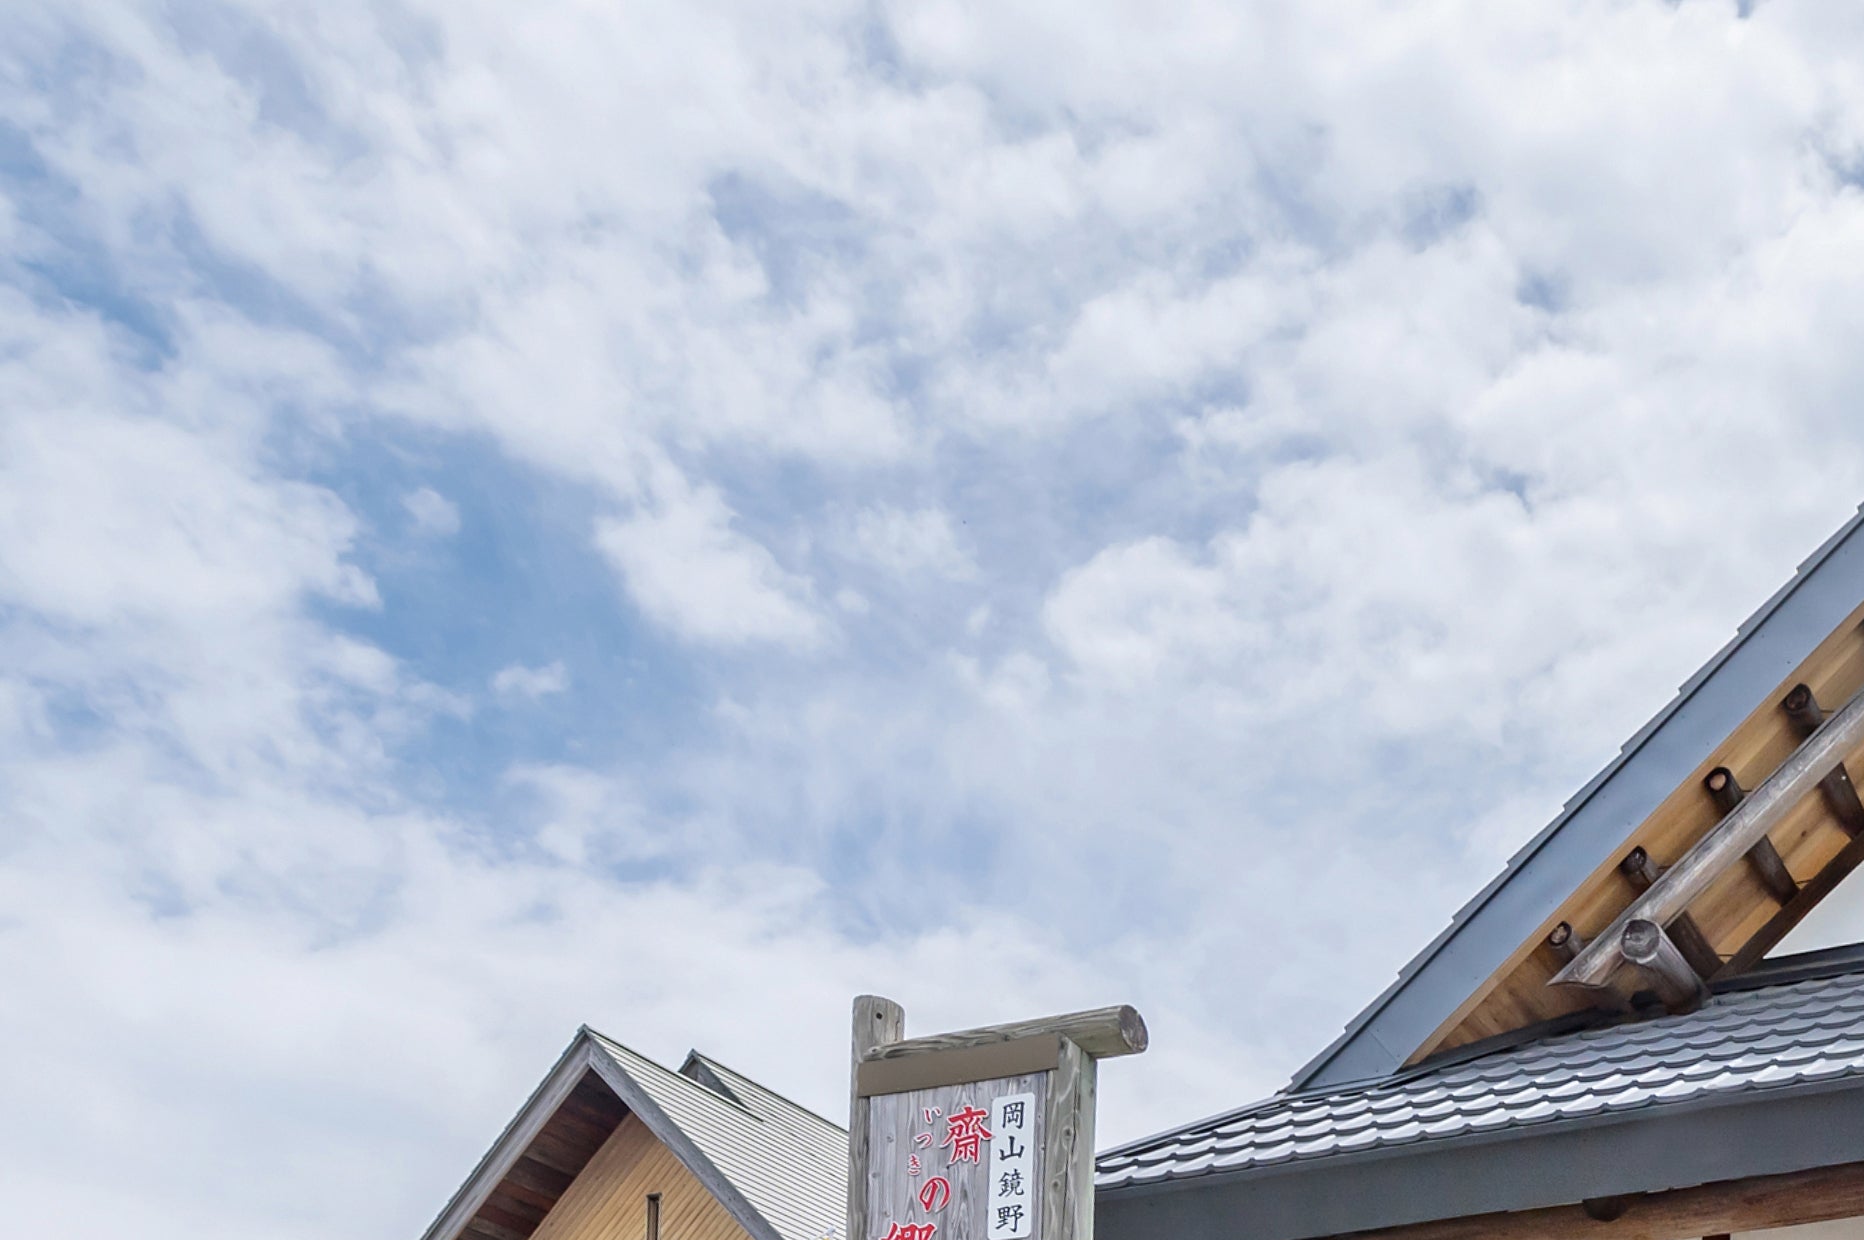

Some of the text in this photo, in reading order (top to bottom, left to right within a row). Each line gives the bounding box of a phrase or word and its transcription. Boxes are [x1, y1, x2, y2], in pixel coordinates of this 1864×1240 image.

[906, 1107, 941, 1176] いつき
[995, 1100, 1026, 1233] 岡山鏡野
